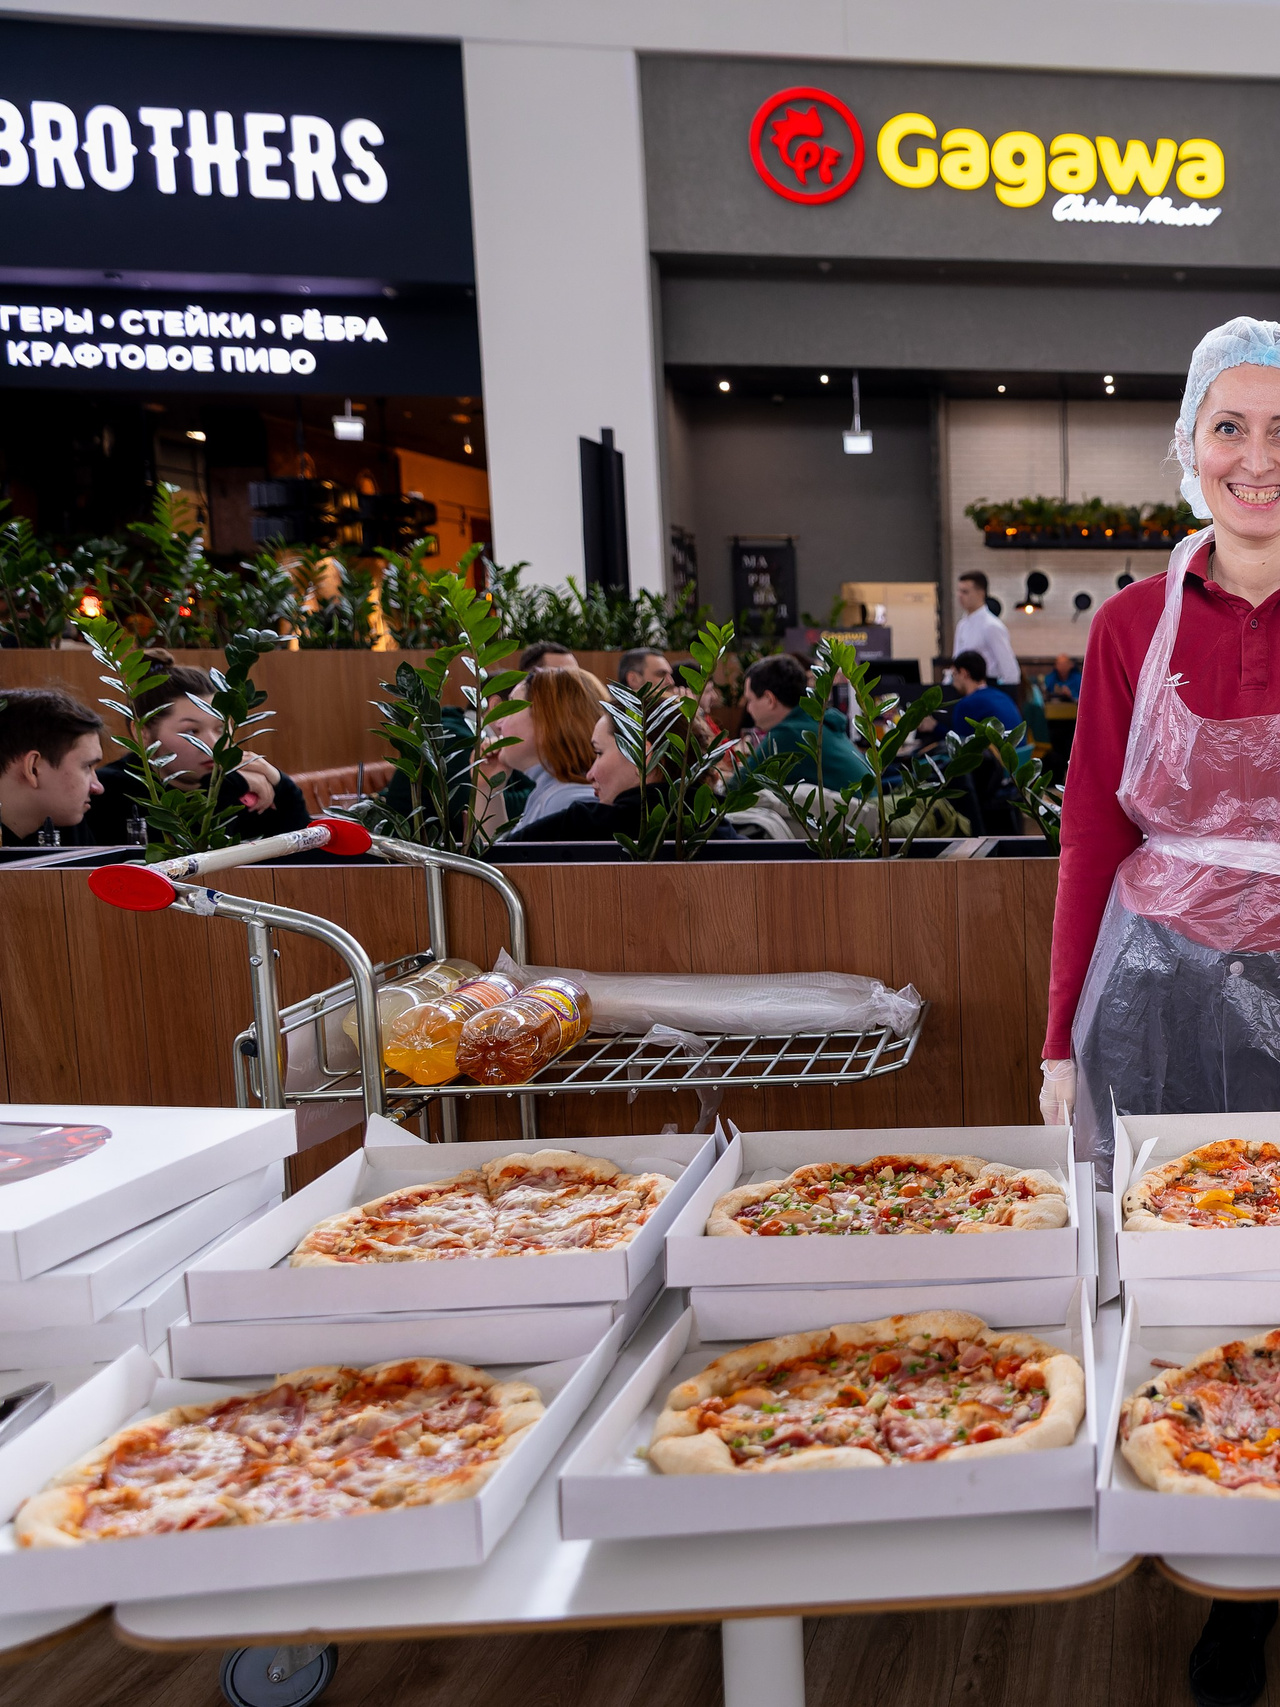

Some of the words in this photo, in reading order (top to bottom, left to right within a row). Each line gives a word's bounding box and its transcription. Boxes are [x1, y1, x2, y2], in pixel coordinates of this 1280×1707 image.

[0, 99, 388, 203] BROTHERS
[876, 112, 1225, 209] Gagawa
[0, 305, 94, 334] ГЕРЫ
[119, 305, 257, 339] СТЕЙКИ
[280, 308, 389, 342] РЁБРА
[7, 341, 215, 372] КРАФТОВОЕ
[220, 346, 317, 375] ПИВО
